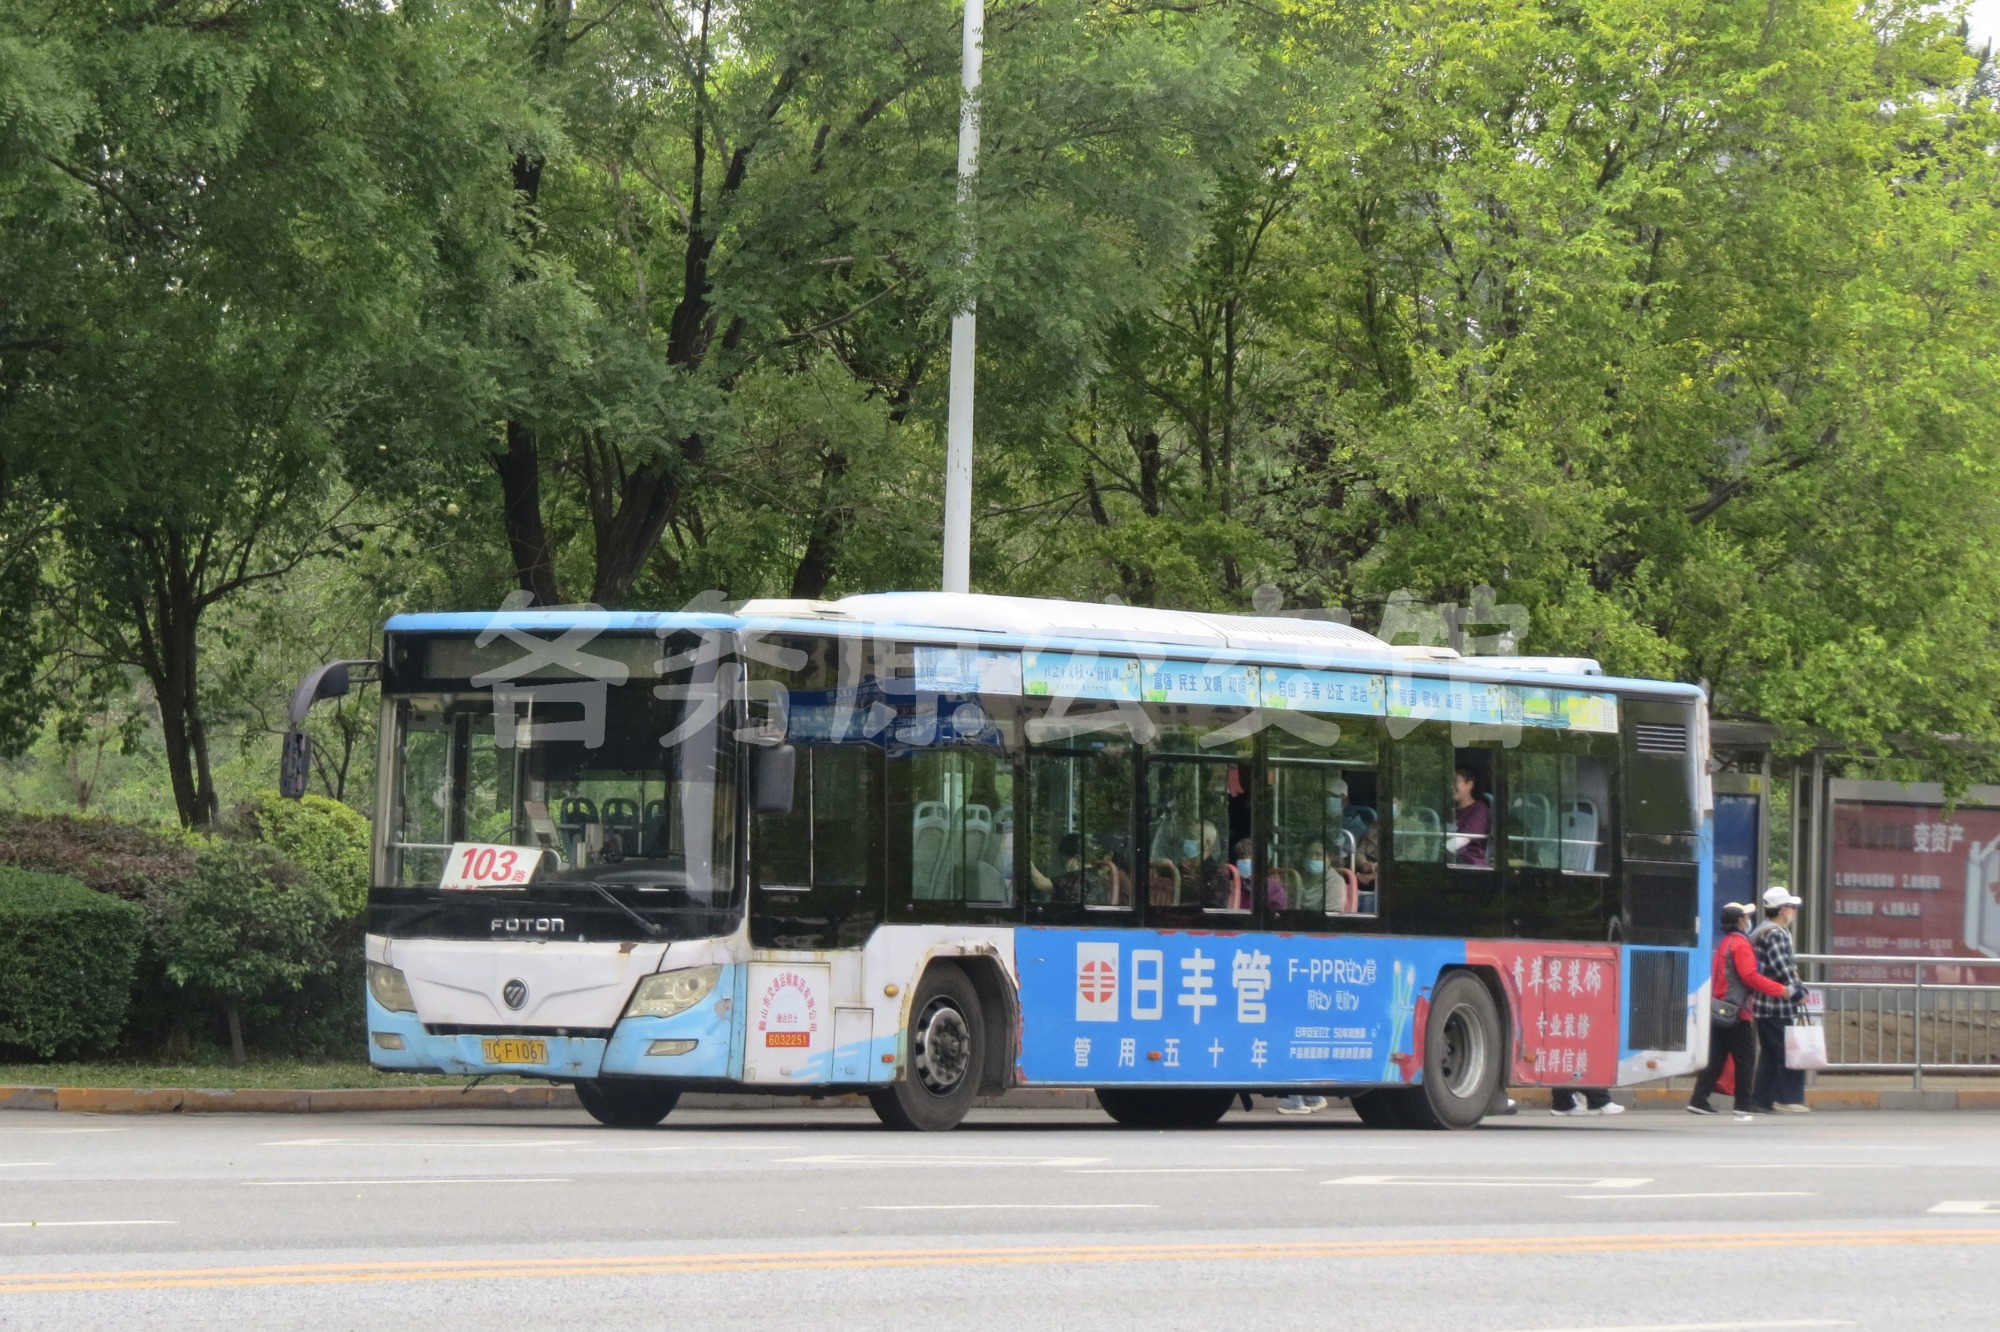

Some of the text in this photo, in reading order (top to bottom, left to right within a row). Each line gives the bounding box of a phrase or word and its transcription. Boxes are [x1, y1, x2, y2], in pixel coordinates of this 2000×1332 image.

[1154, 673, 1247, 693] 富强 民主 文明 和谐
[1279, 680, 1368, 703] 自由 平等 公正 法治
[1400, 689, 1488, 712] 爱国 敬业 诚信 友善
[1913, 822, 1964, 852] 变资产
[491, 918, 565, 932] FOTON
[1131, 948, 1271, 1024] 日丰管
[1512, 955, 1601, 998] 青苹果装饰
[1536, 1010, 1590, 1039] 专业装修
[768, 1034, 807, 1046] 6032251
[1074, 1037, 1268, 1069] 管用五十年
[1534, 1047, 1588, 1073] 值得信赖
